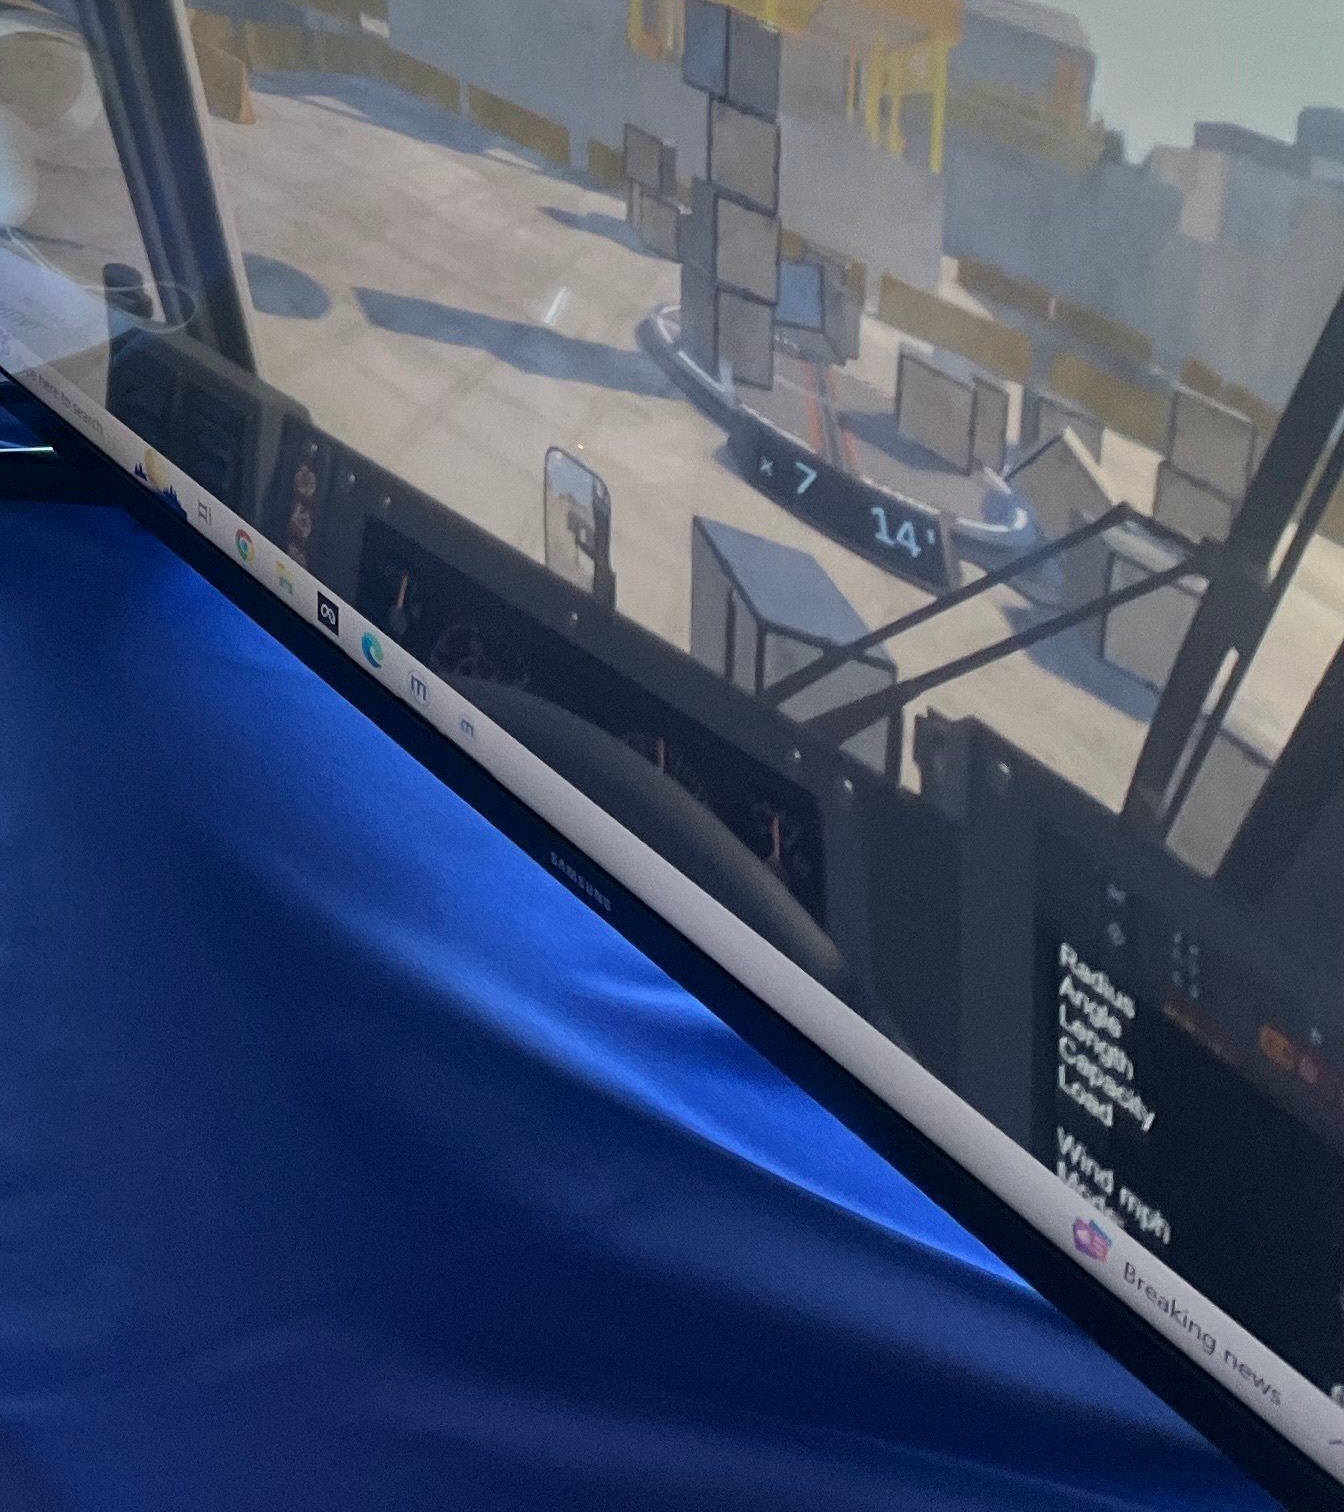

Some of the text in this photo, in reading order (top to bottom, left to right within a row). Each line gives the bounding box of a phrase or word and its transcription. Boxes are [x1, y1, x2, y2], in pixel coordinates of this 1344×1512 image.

[1059, 942, 1136, 1019] Radius
[1059, 975, 1123, 1039] Angle
[1059, 1003, 1135, 1081] Length
[1058, 1036, 1155, 1132] Capacity
[1058, 1065, 1113, 1128] Load
[1057, 1125, 1171, 1245] Wind mph
[1123, 1261, 1283, 1408] Breaking news
